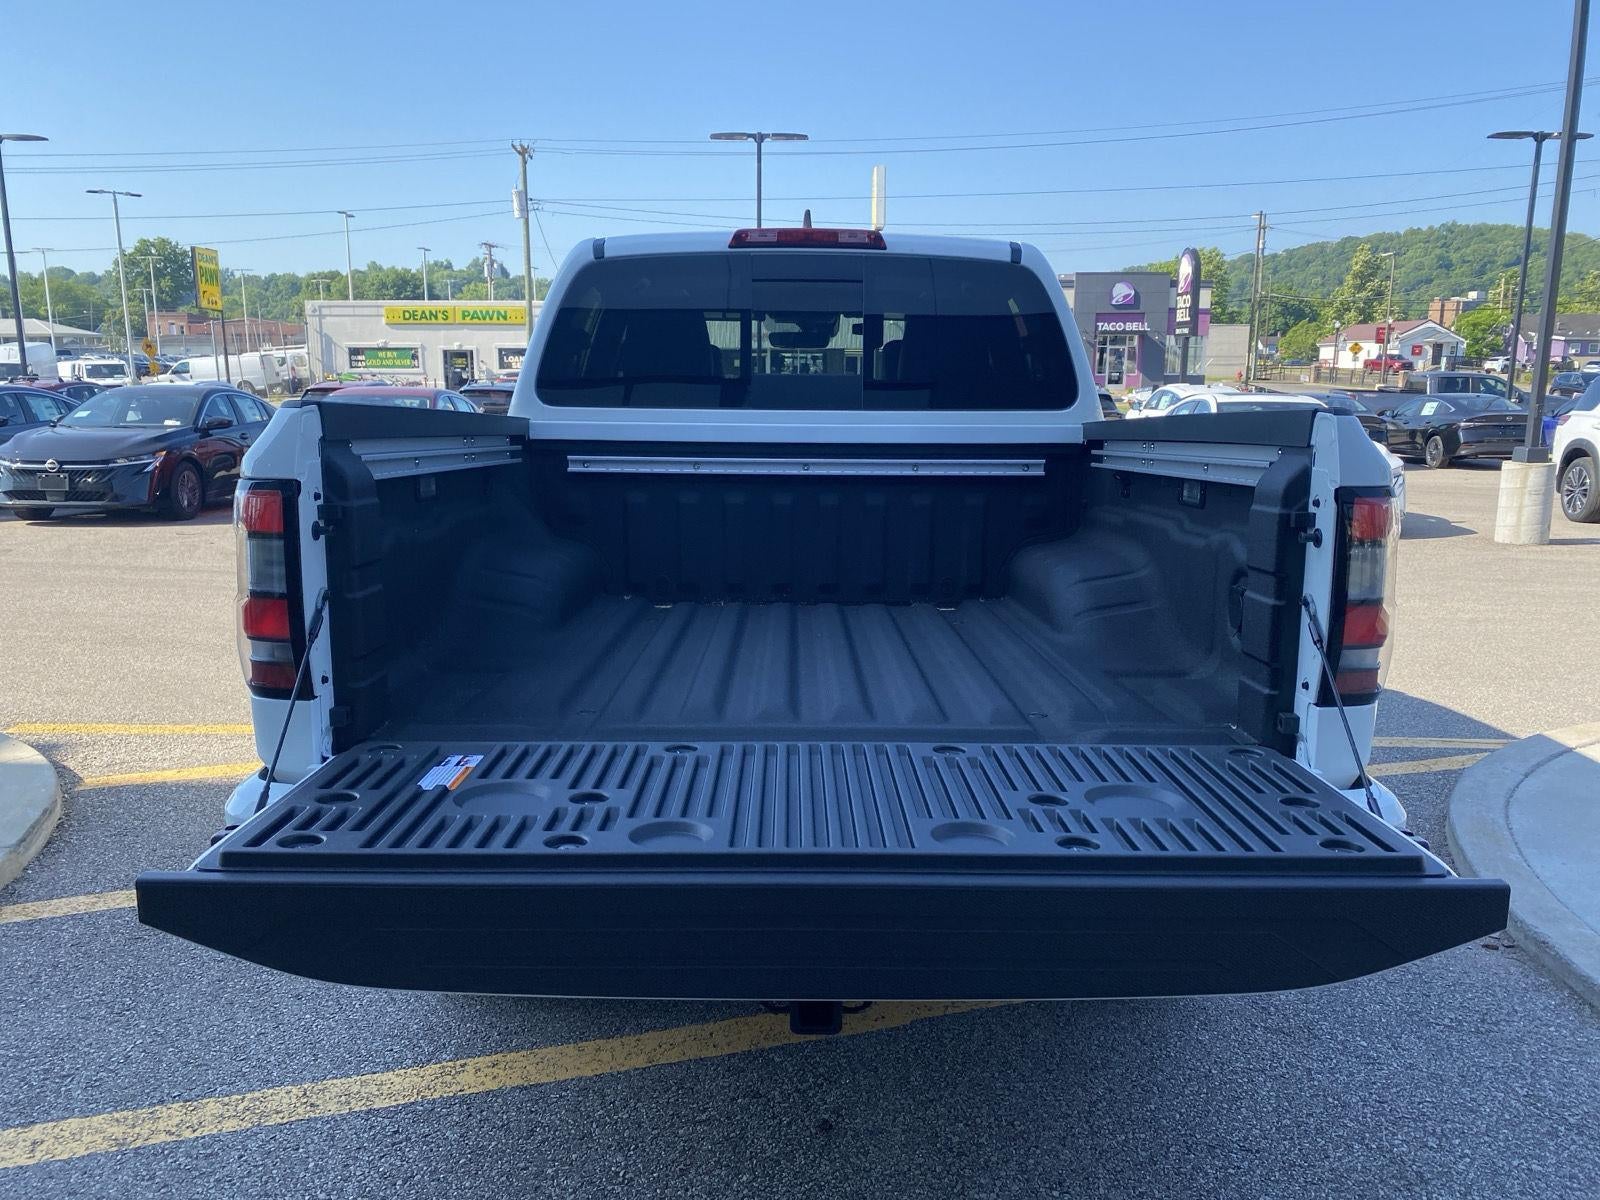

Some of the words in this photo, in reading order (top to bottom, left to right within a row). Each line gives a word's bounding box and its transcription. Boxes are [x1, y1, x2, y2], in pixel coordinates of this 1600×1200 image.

[1176, 295, 1191, 309] TACO
[402, 310, 449, 321] DEAN'S
[461, 310, 508, 321] PAWN
[1175, 308, 1190, 322] BELL
[1096, 322, 1125, 331] TACO
[1125, 322, 1150, 331] BELL
